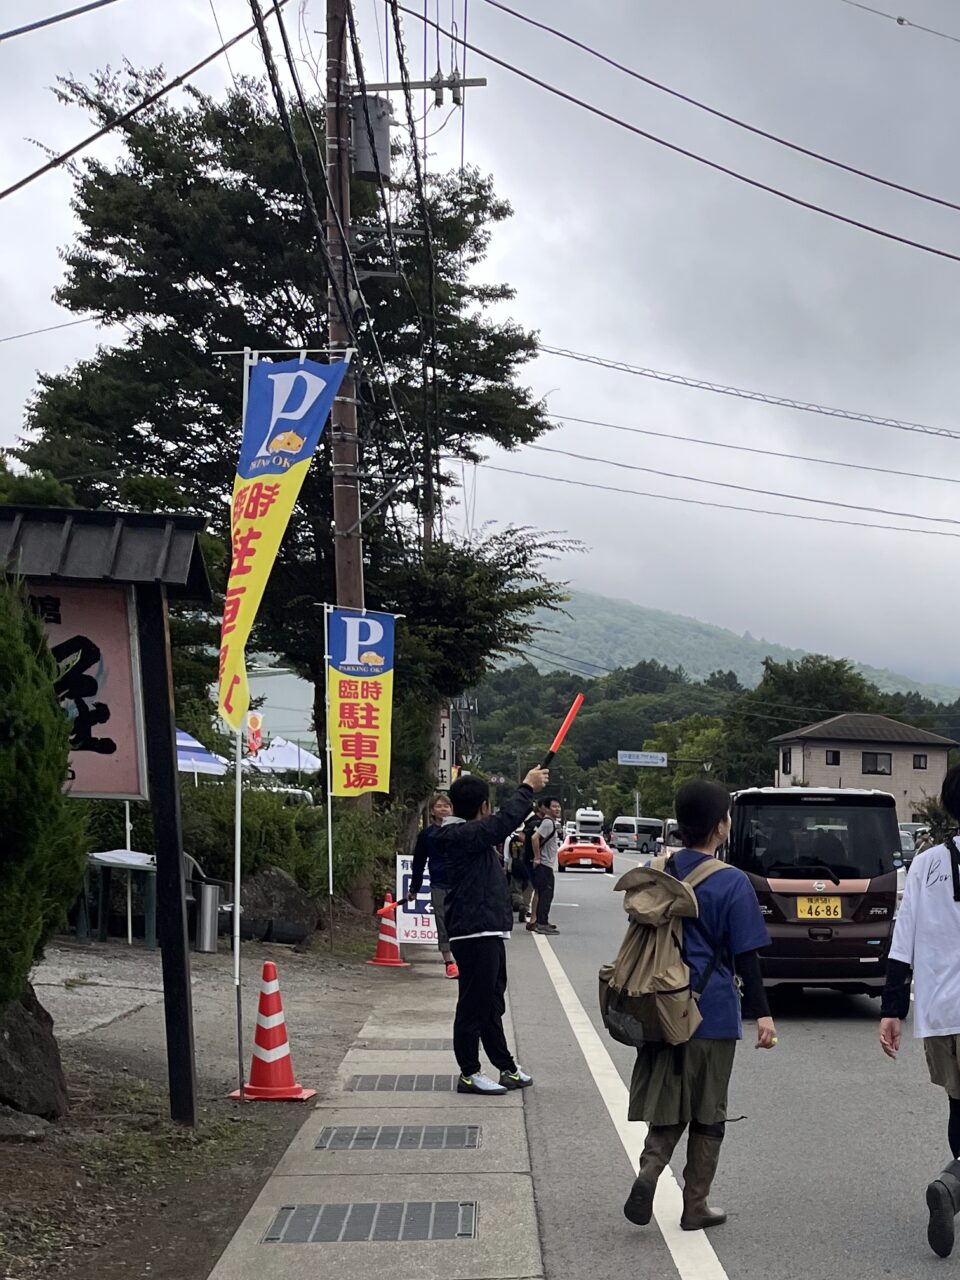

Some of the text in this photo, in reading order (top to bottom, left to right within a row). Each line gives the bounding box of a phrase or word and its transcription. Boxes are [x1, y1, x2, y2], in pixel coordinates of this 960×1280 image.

[256, 370, 327, 458] P
[339, 616, 384, 666] P
[338, 665, 369, 673] PARKING
[338, 679, 382, 701] 臨時
[338, 702, 381, 789] 駐車場
[807, 905, 839, 917] 46-86
